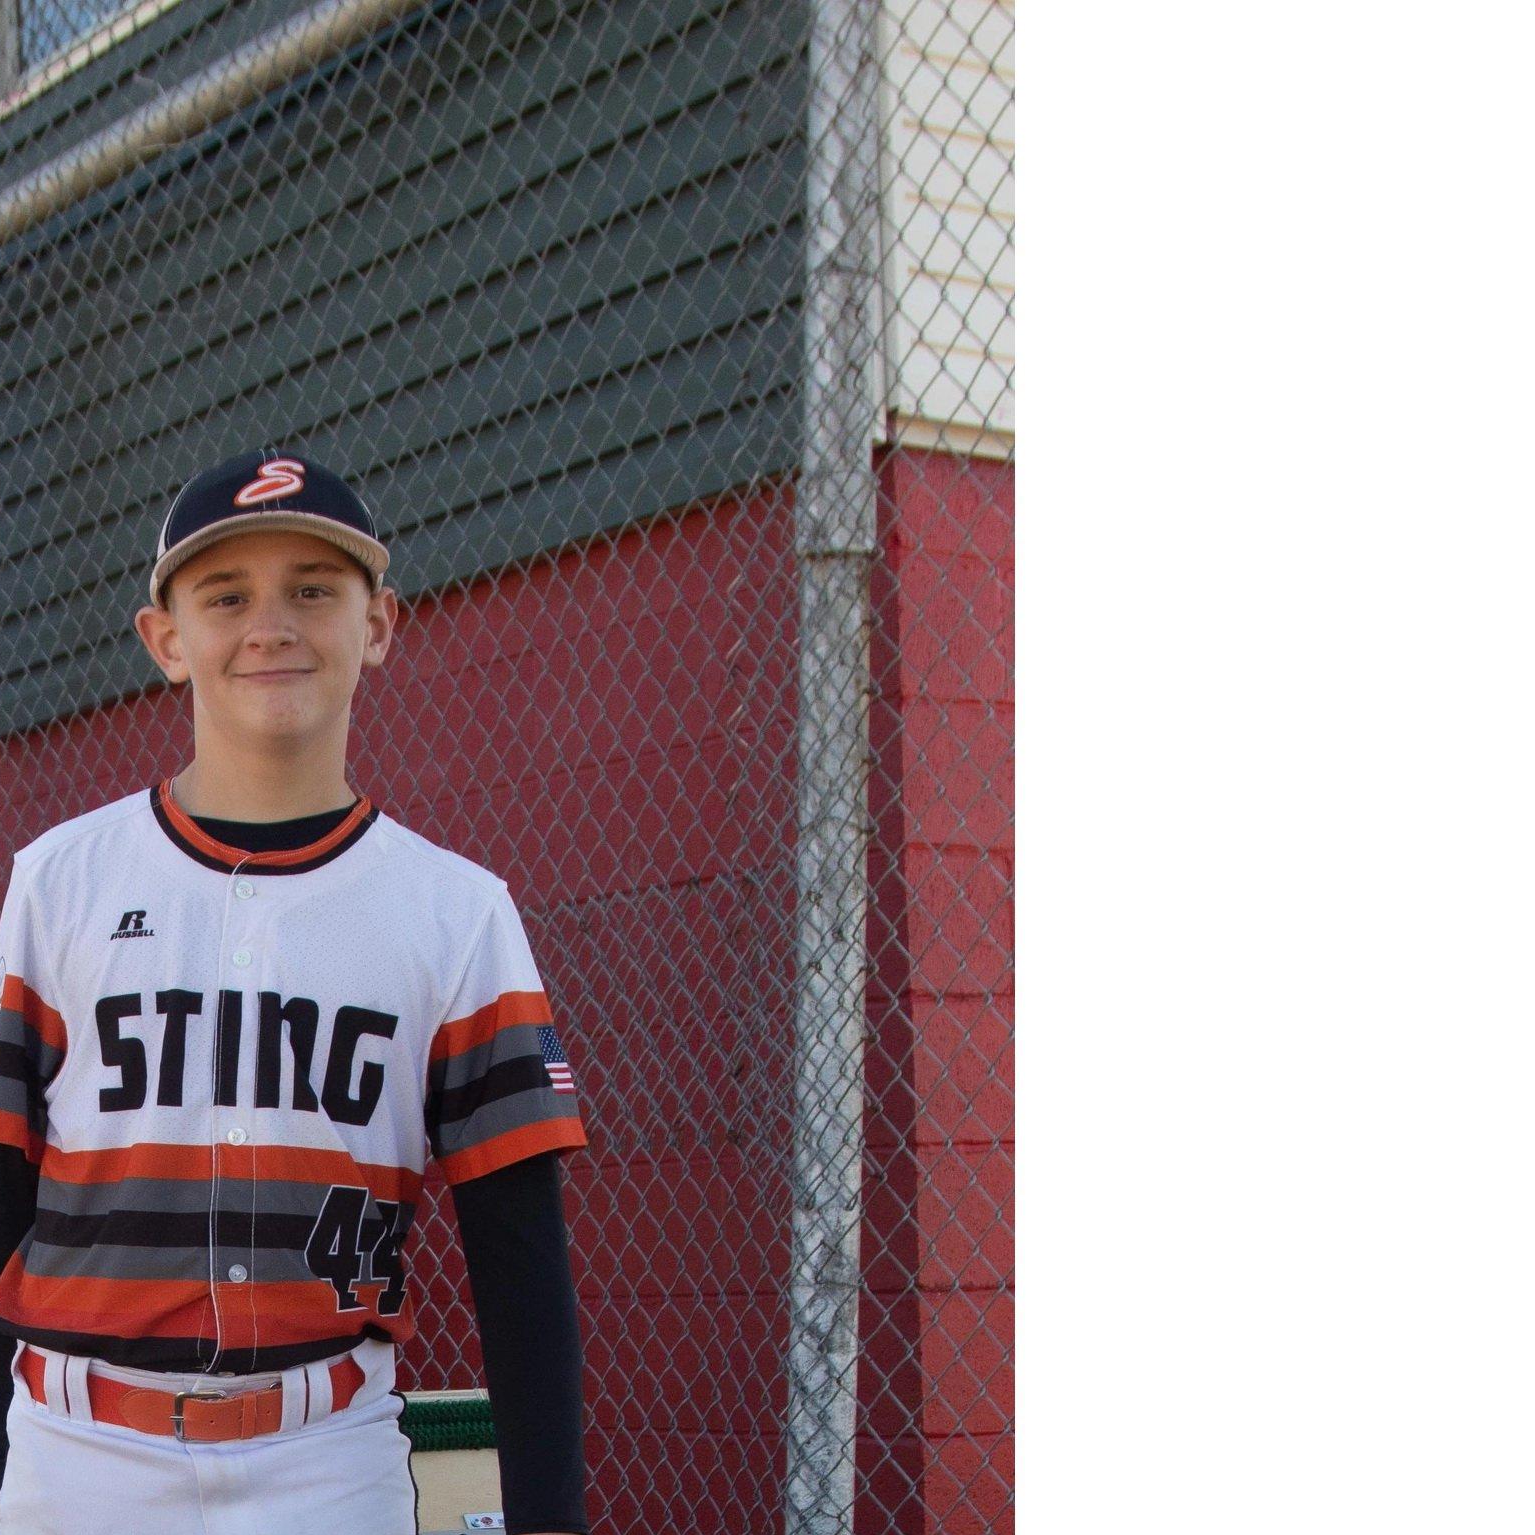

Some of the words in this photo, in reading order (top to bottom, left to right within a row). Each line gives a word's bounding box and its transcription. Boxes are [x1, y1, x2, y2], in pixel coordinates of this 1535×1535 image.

[233, 457, 307, 508] S
[110, 929, 155, 941] RUSSELL
[94, 988, 399, 1126] STING
[304, 1185, 409, 1317] 44
